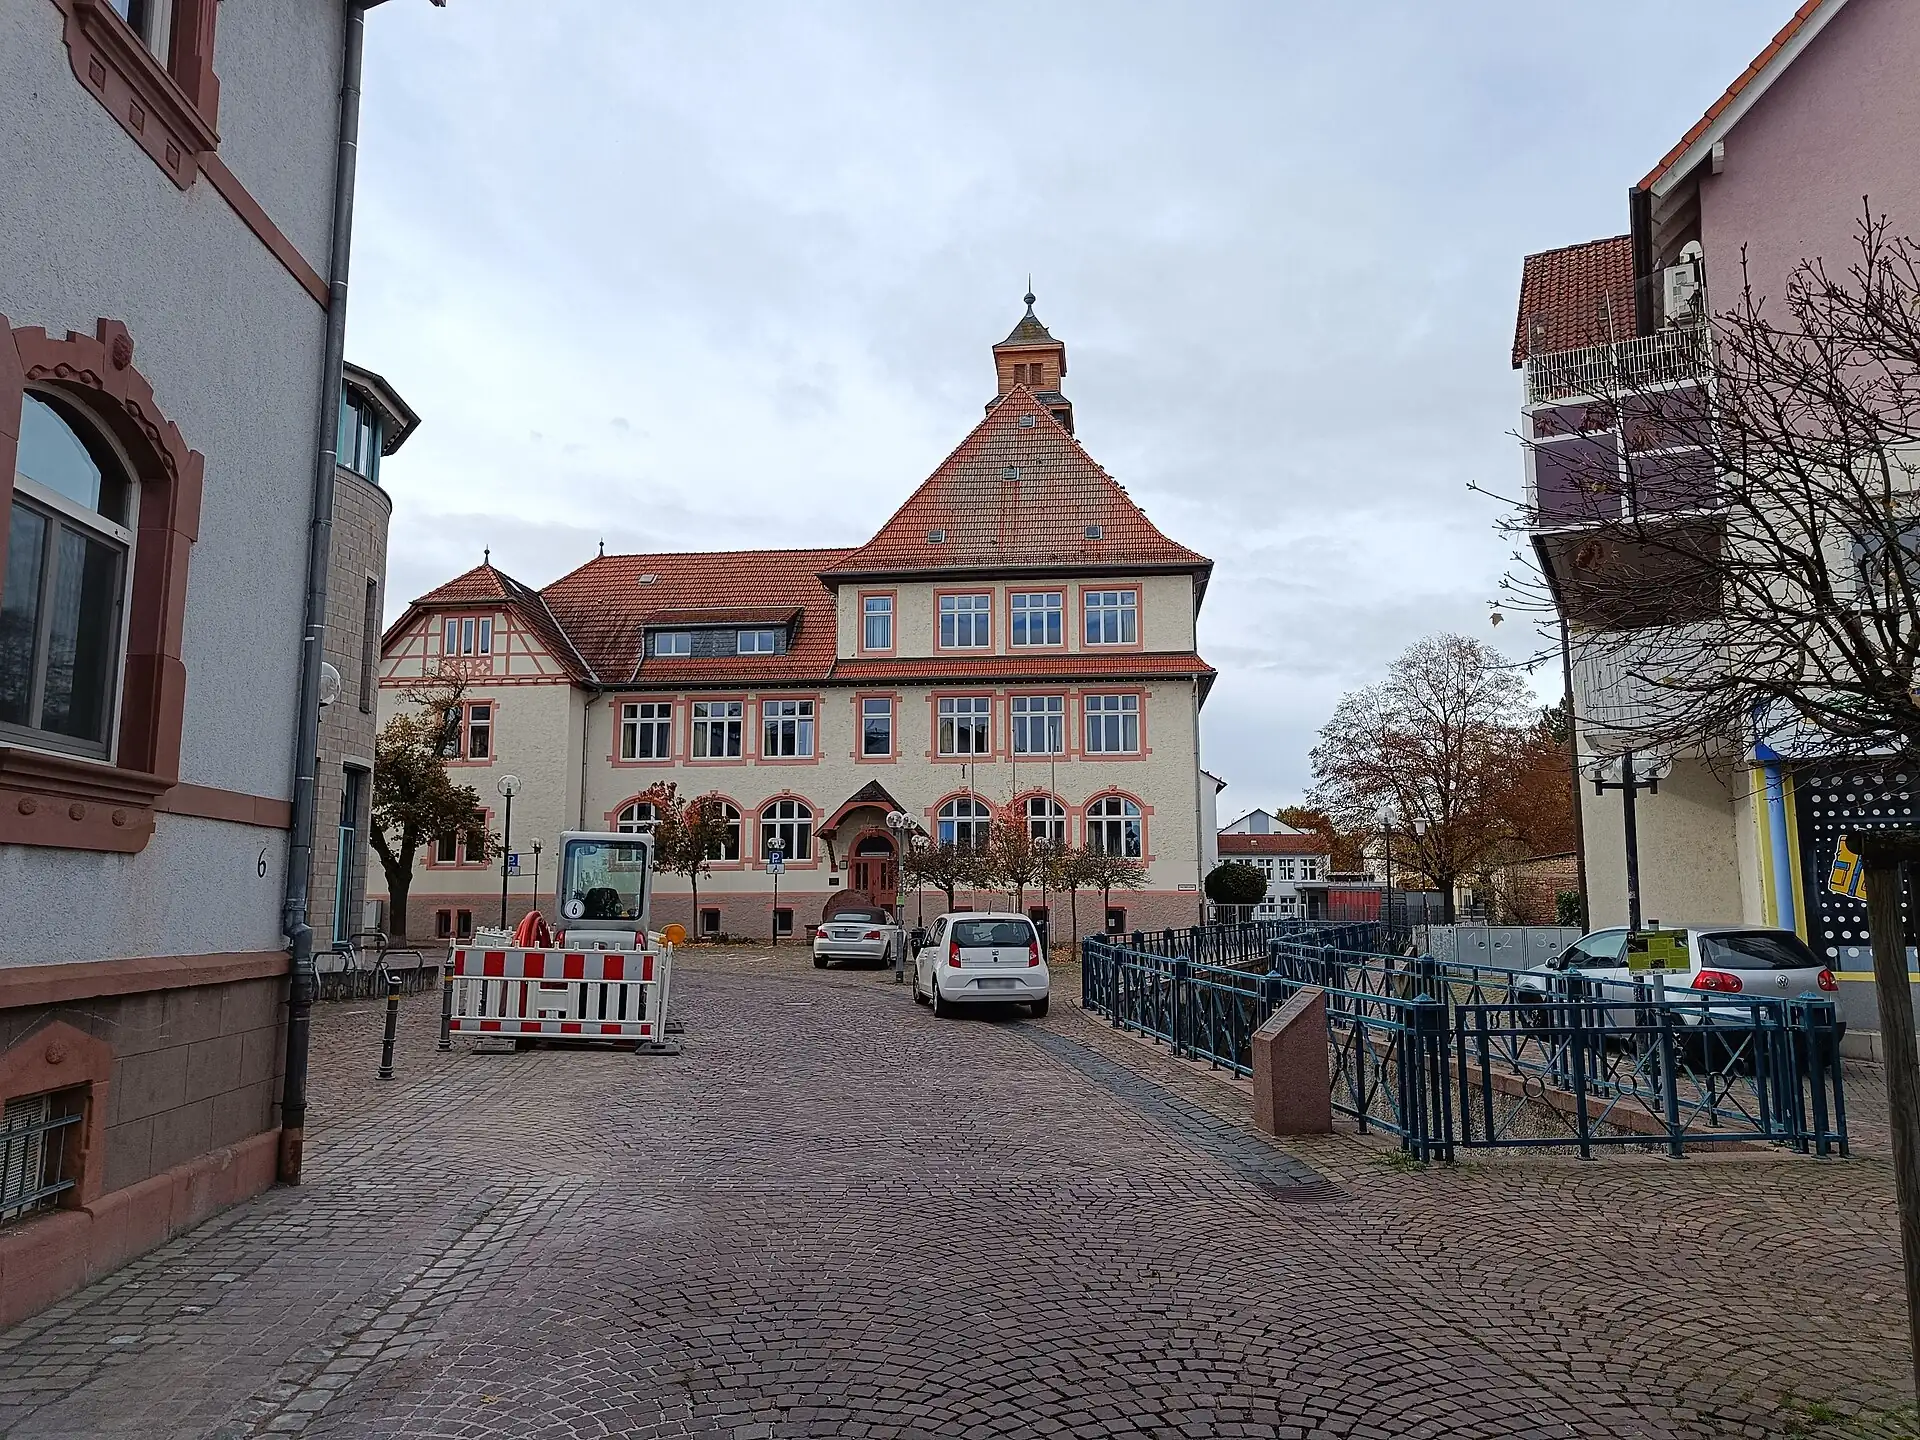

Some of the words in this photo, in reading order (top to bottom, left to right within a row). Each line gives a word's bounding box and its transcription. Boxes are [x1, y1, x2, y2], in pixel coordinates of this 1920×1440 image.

[257, 847, 267, 878] 6
[772, 852, 780, 863] P
[571, 902, 578, 916] 6
[1467, 931, 1478, 946] 1
[1500, 932, 1513, 948] 2
[1534, 932, 1547, 948] 3
